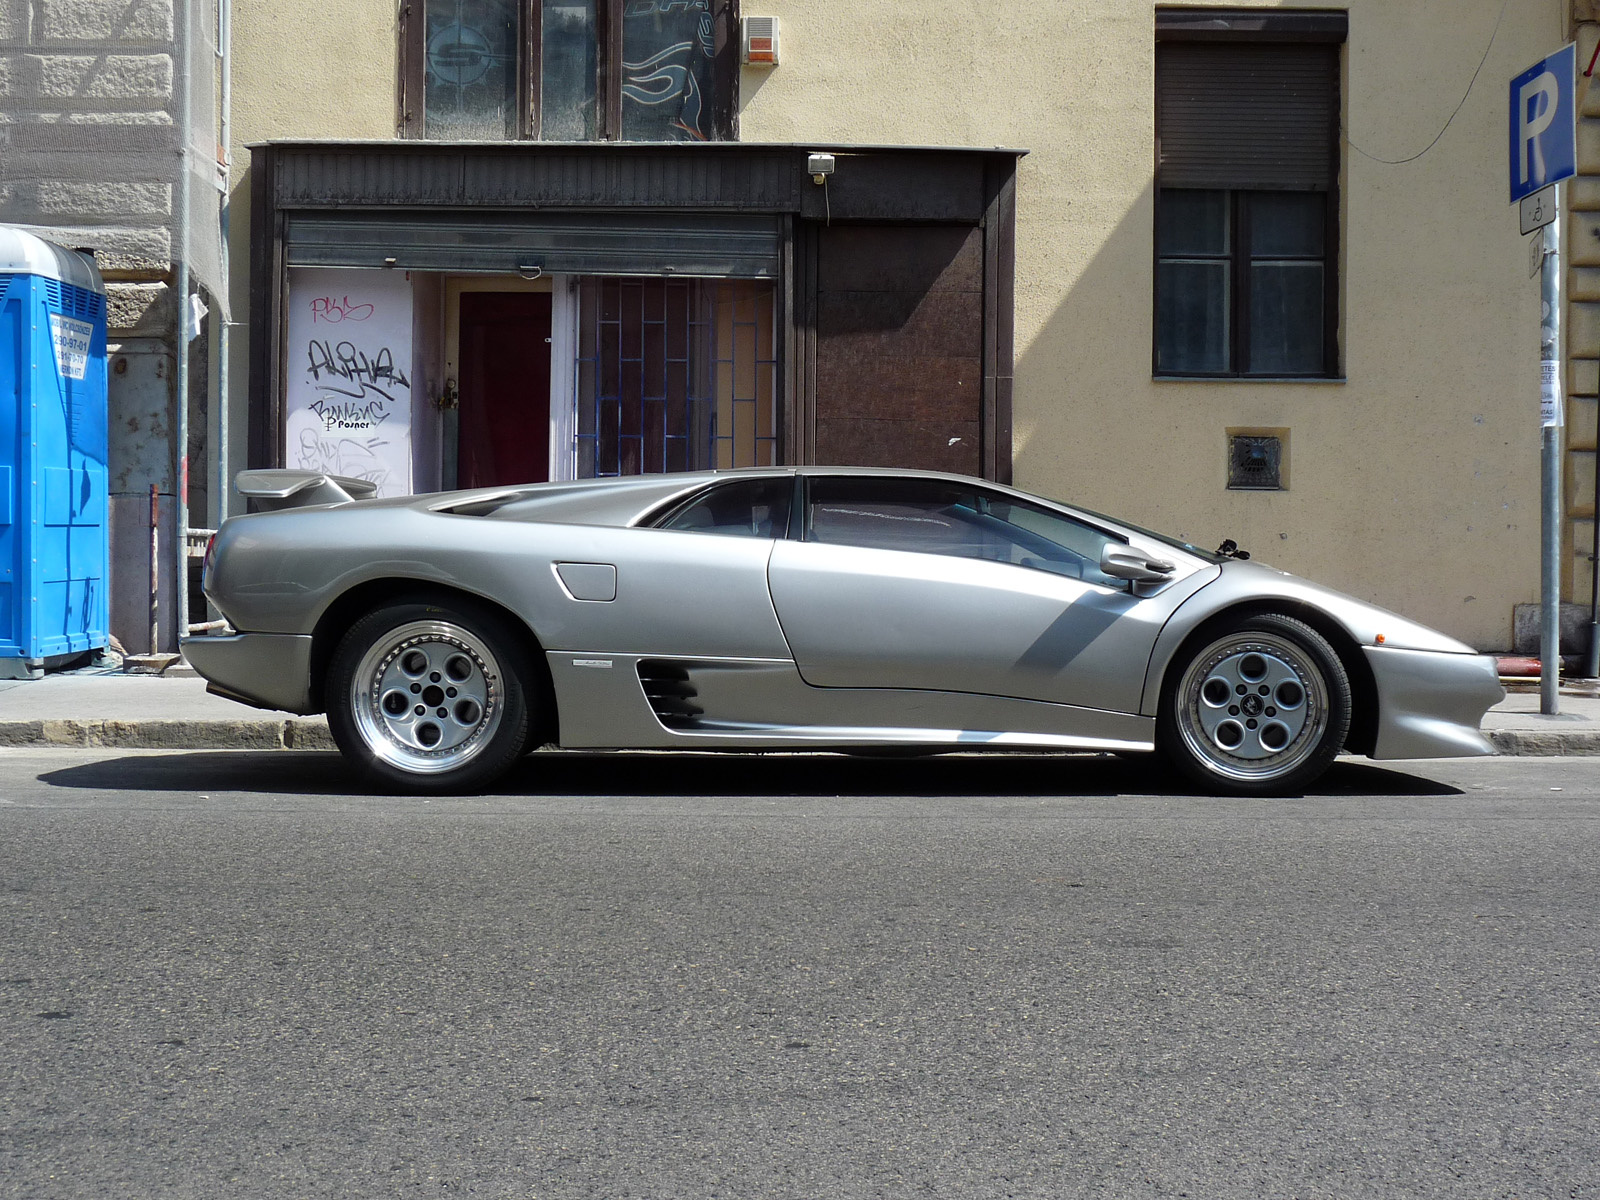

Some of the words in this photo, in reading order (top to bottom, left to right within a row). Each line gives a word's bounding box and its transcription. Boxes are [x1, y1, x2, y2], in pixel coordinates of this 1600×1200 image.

[1520, 71, 1558, 184] P
[54, 335, 87, 351] 290-97-01
[338, 420, 369, 429] Posner
